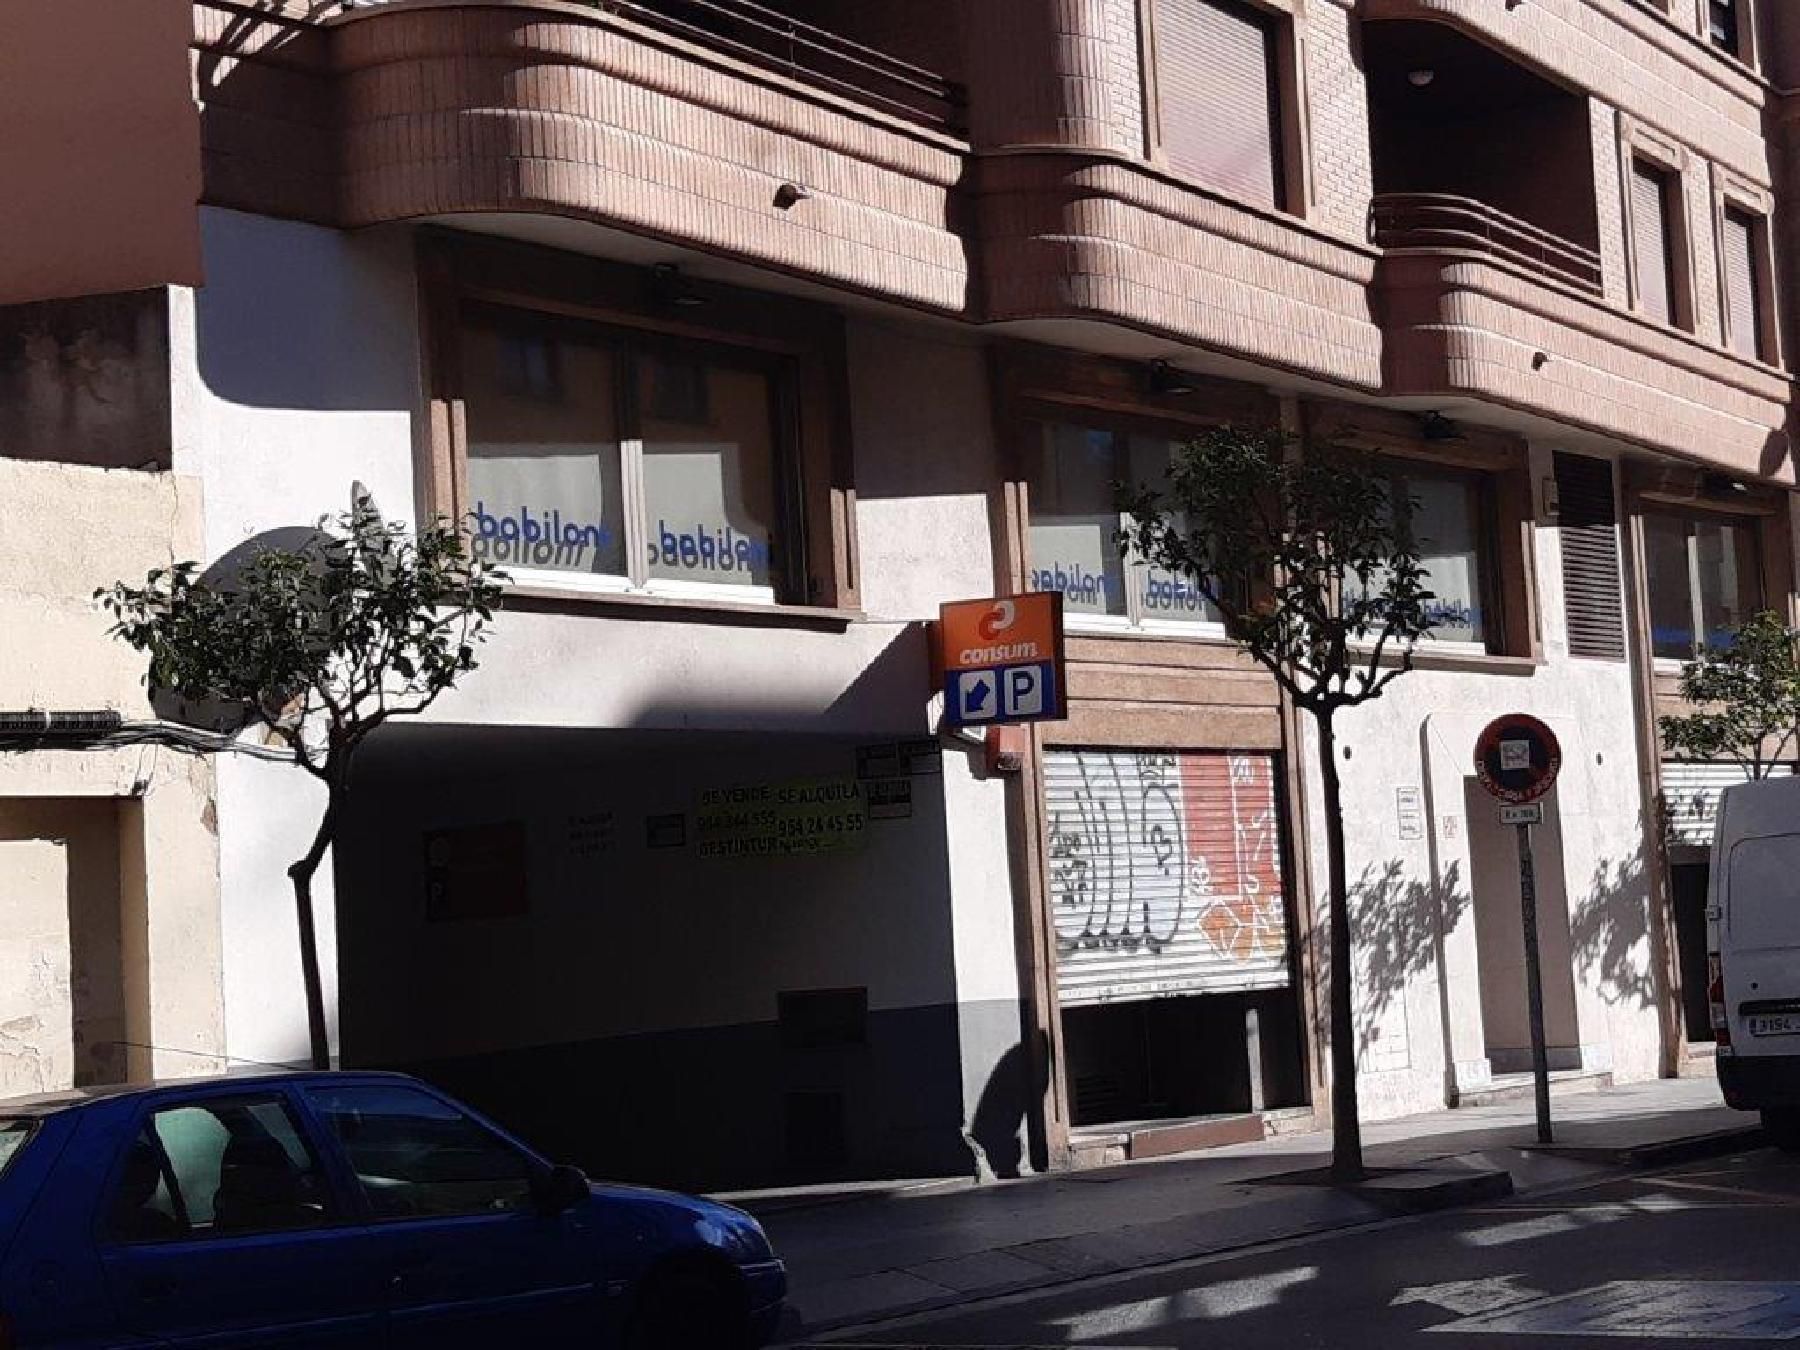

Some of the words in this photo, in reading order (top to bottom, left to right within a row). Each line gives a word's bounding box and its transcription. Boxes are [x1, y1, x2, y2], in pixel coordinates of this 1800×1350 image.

[960, 641, 1038, 665] consum
[1013, 670, 1035, 711] P
[721, 786, 770, 803] VENDE
[797, 783, 860, 803] ALQUILA
